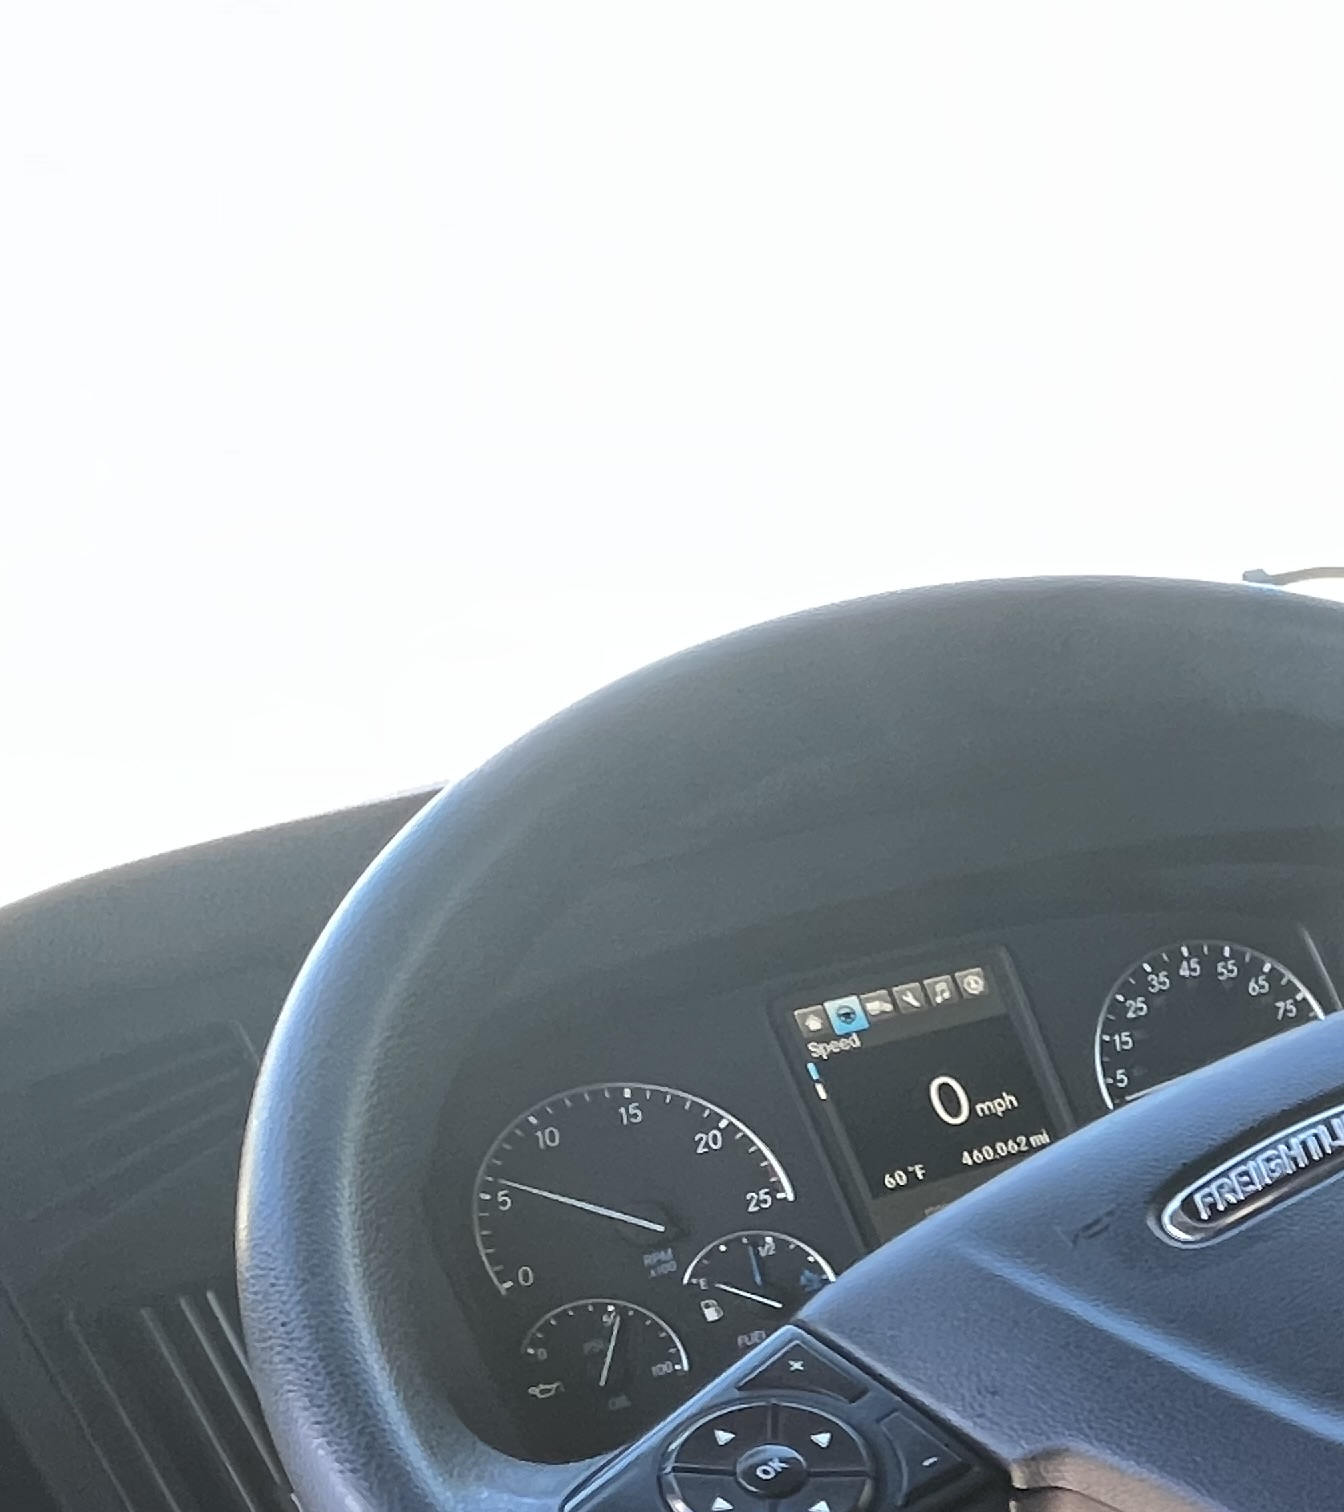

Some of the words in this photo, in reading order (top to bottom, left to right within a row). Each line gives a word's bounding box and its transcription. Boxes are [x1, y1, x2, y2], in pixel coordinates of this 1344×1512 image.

[1179, 958, 1201, 979] 45
[1216, 960, 1238, 982] 55
[1147, 971, 1170, 994] 35
[1248, 976, 1270, 997] 65
[1125, 997, 1148, 1019] 25
[1275, 999, 1297, 1021] 75
[807, 1032, 861, 1060] Speed
[1113, 1031, 1134, 1051] 15
[1116, 1069, 1129, 1088] 5
[929, 1076, 971, 1126] 0
[975, 1092, 1019, 1118] mph
[618, 1103, 642, 1125] 15
[535, 1126, 560, 1149] 10
[694, 1129, 723, 1155] 20
[1029, 1129, 1050, 1149] mi
[884, 1169, 907, 1189] 60
[497, 1190, 511, 1211] 5
[746, 1189, 772, 1213] 25
[518, 1266, 534, 1286] 0
[755, 1456, 790, 1482] OK
